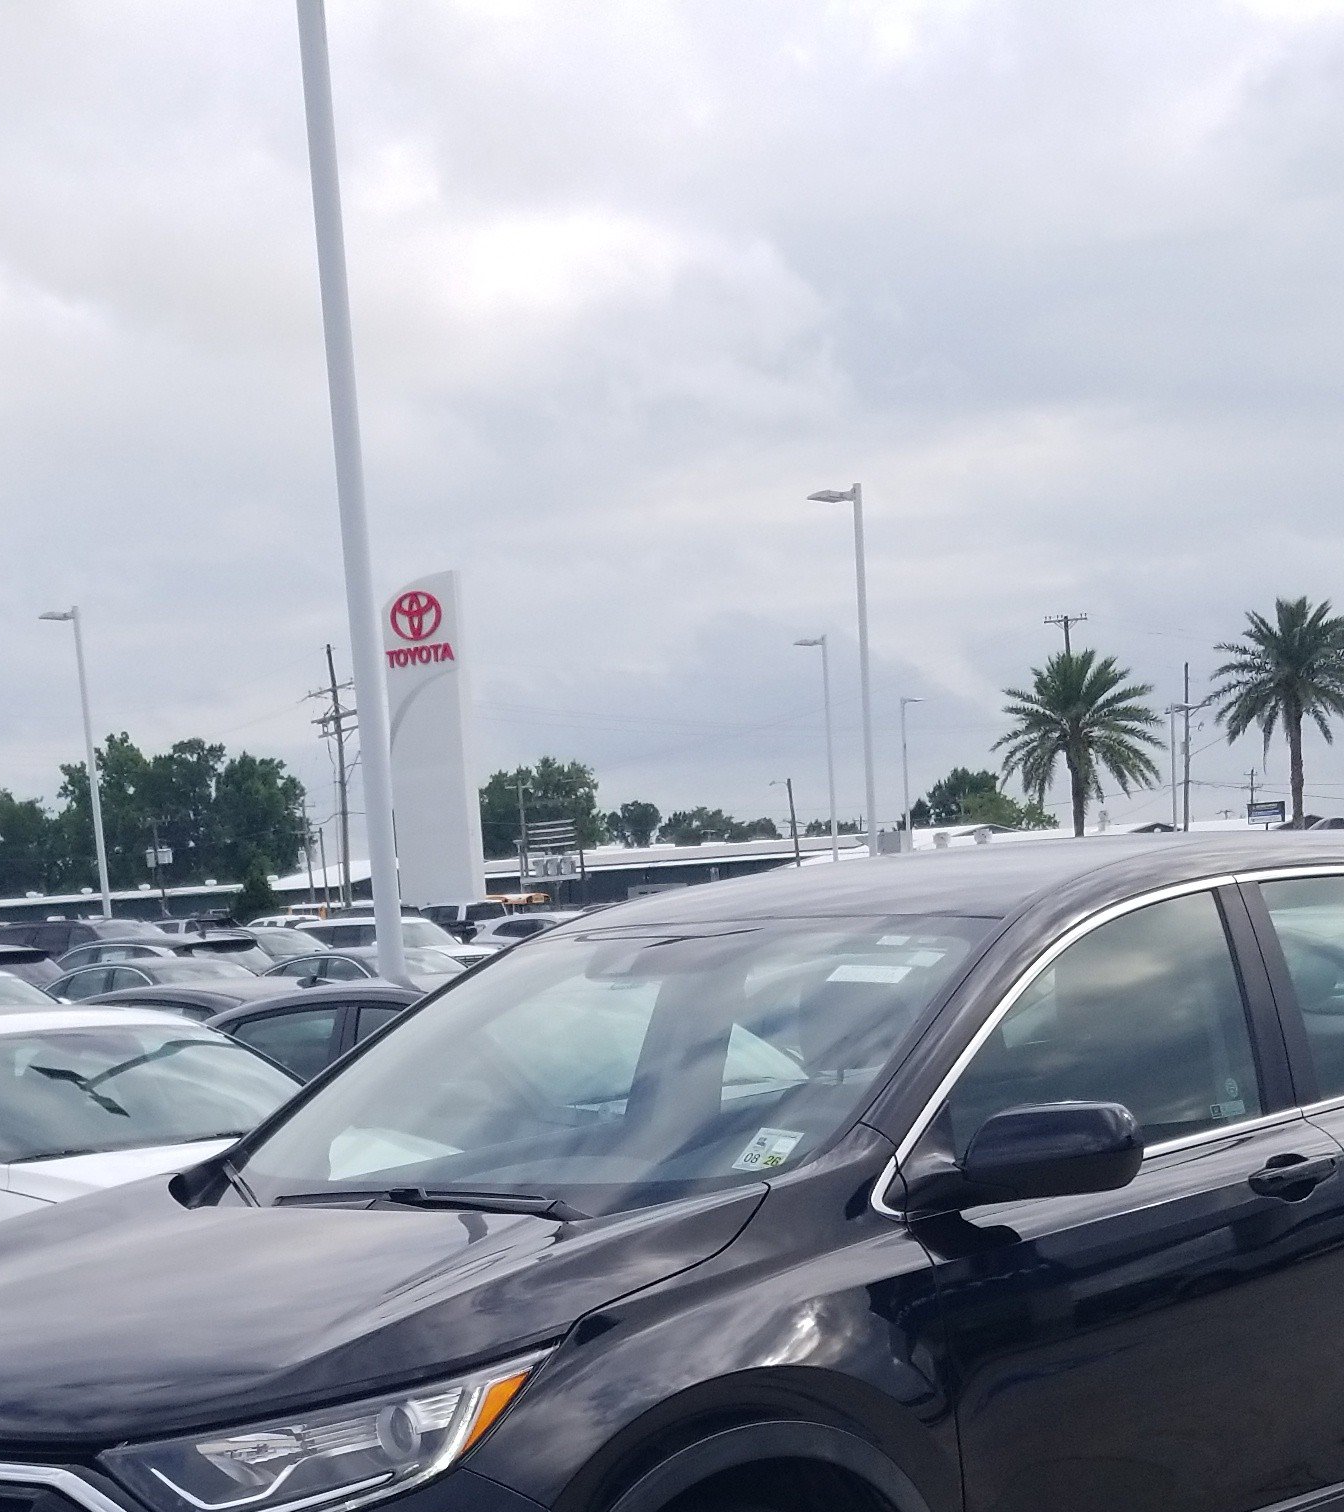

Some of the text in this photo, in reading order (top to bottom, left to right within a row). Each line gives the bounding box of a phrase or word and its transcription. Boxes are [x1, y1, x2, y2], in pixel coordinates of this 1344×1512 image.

[385, 642, 455, 669] TOYOTA
[743, 1152, 782, 1167] 08 26
